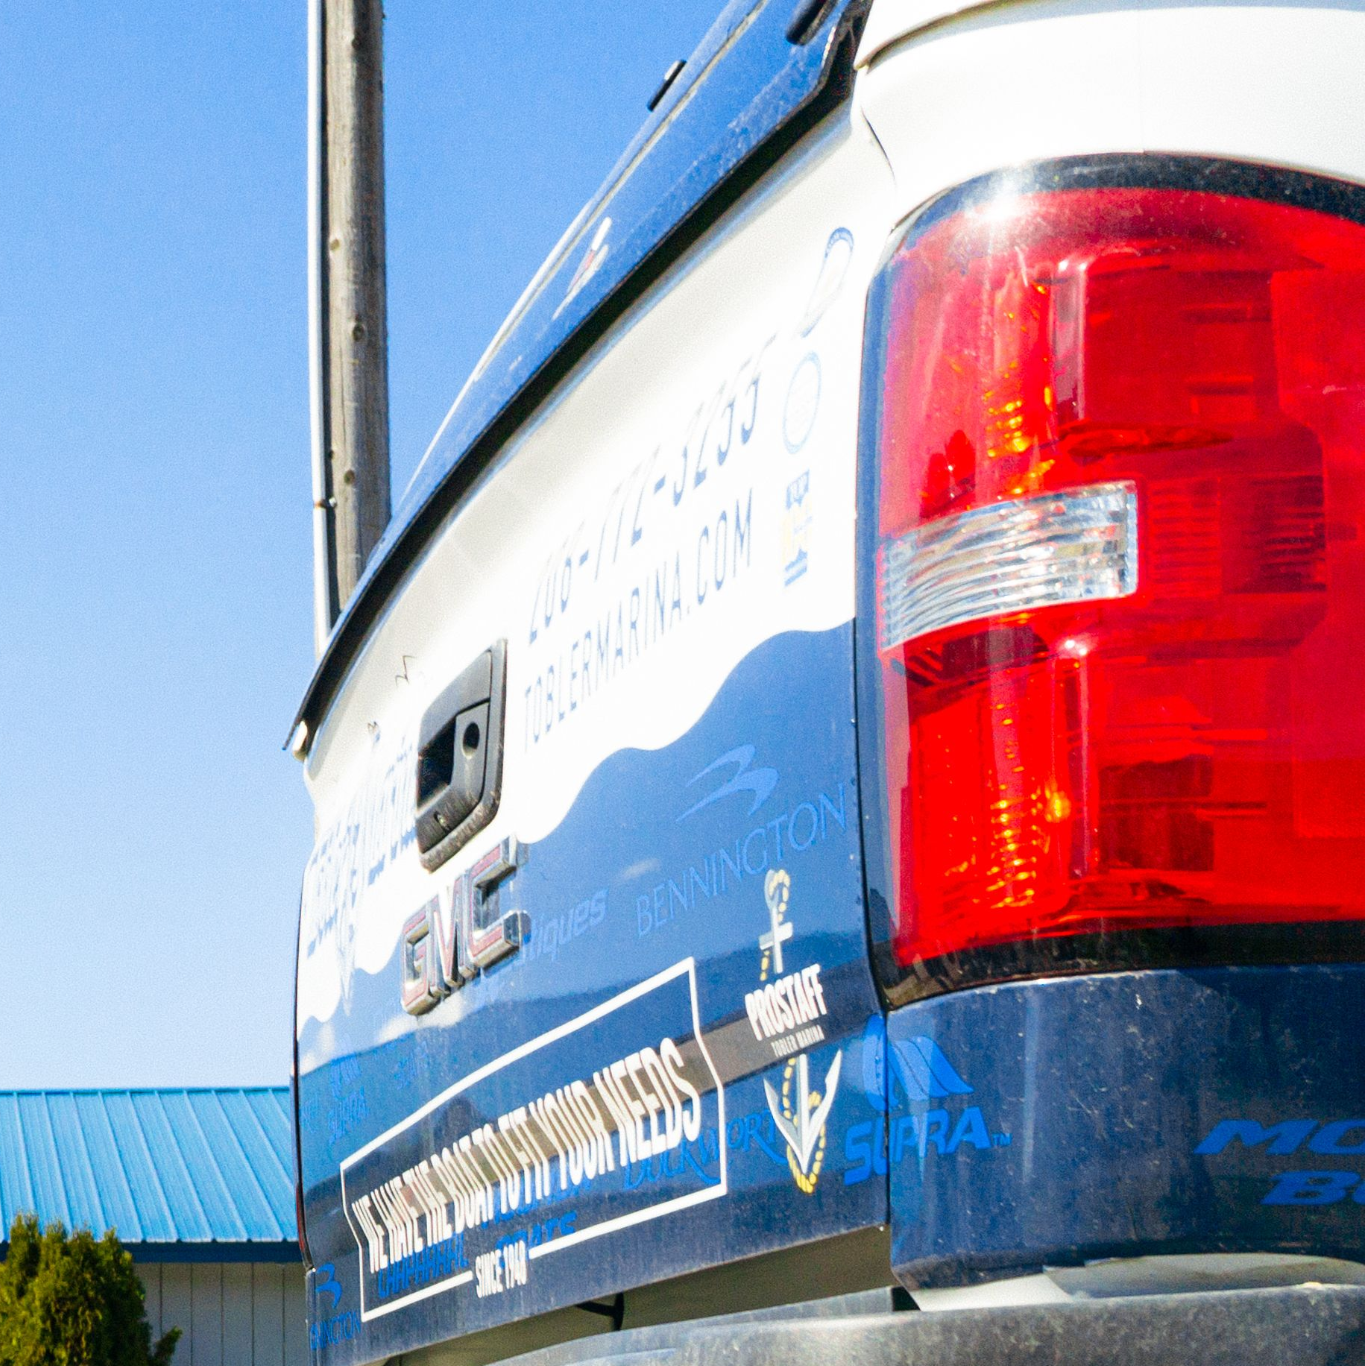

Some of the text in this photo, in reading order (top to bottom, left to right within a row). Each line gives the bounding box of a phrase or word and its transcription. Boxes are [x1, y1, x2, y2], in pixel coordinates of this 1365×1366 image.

[525, 487, 752, 754] TOBLERMARINA.COM
[400, 838, 529, 1015] GMC
[636, 783, 846, 937] BENNINGTON
[745, 963, 827, 1041] PROSTAFF
[351, 1194, 388, 1274] WE
[371, 1175, 424, 1265] HAVE
[402, 1159, 452, 1247] THE
[430, 1134, 493, 1234] BOAT
[471, 1122, 525, 1214] TO
[498, 1106, 550, 1204] FIT
[528, 1080, 616, 1191] YOUR
[593, 1037, 701, 1167] NEEDS
[844, 1106, 991, 1186] SUPRA
[475, 1249, 503, 1298] SINCE
